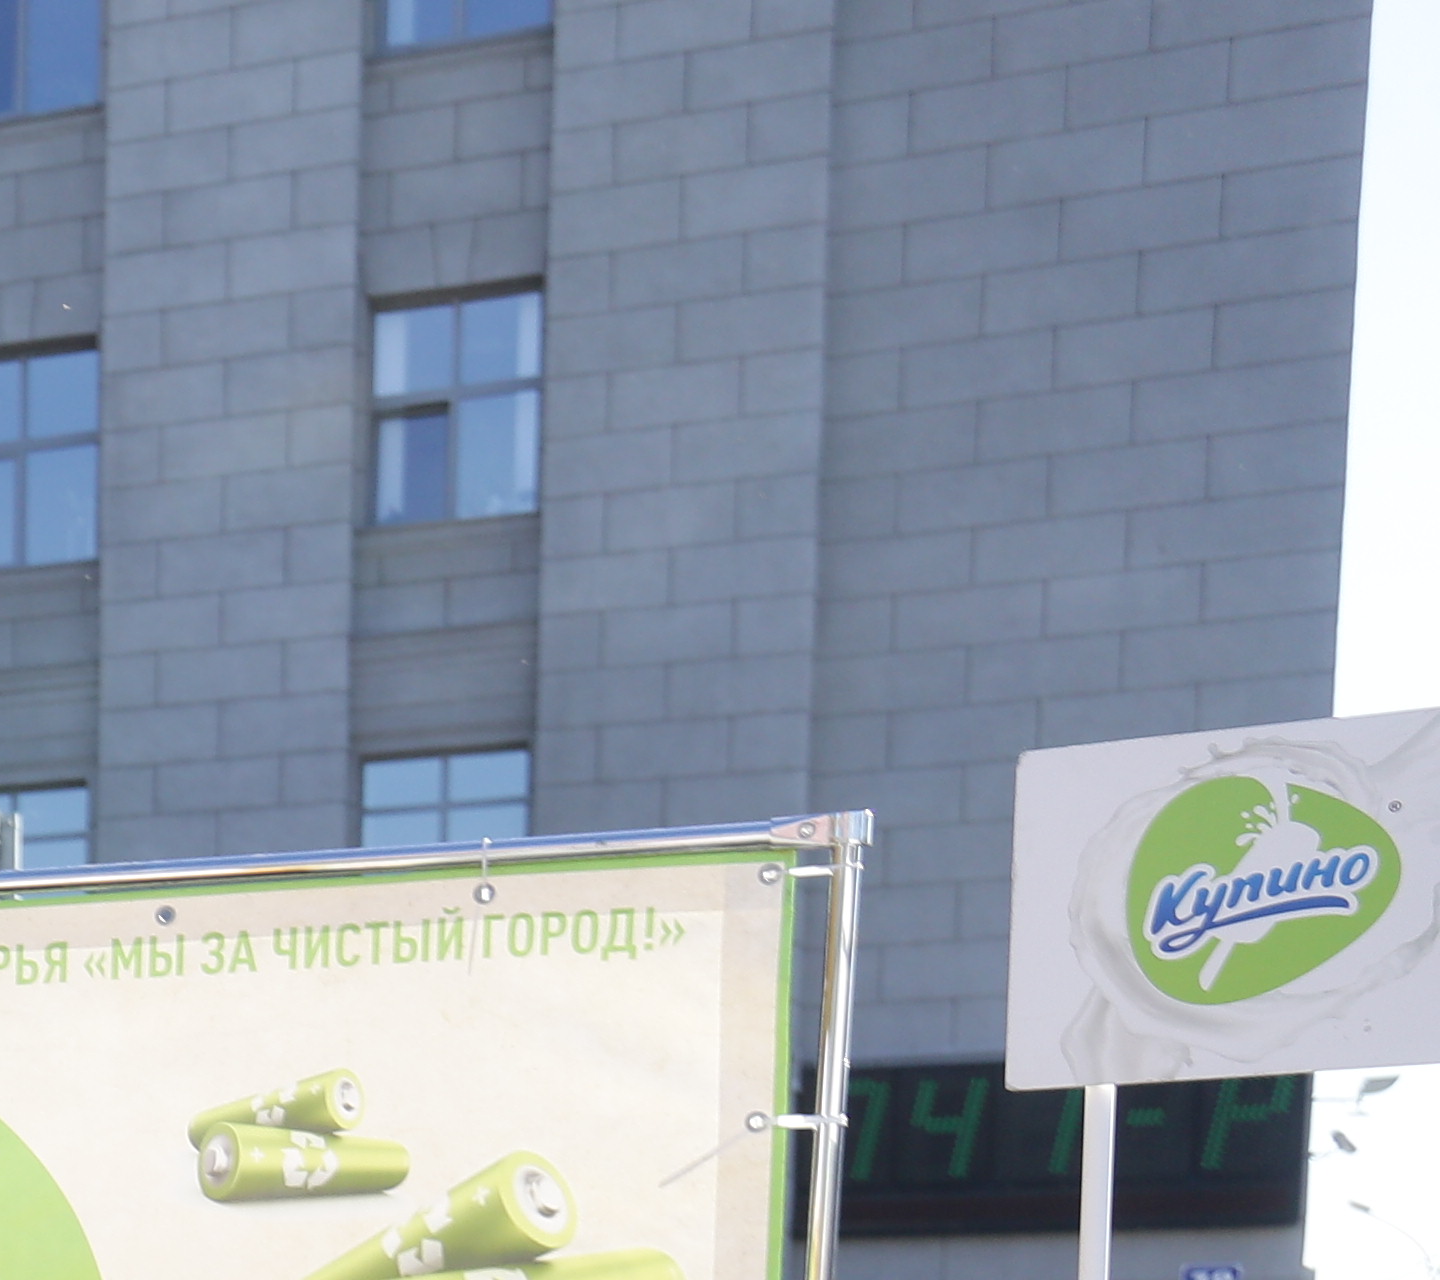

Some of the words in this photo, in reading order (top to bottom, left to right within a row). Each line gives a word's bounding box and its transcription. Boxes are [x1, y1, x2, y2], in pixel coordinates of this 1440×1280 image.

[84, 935, 186, 981] «МЫ
[200, 929, 259, 976] ЗА
[272, 905, 466, 970] ЧИСТЫЙ
[482, 906, 686, 962] ГОРОД!»
[1151, 851, 1370, 953] Купино
